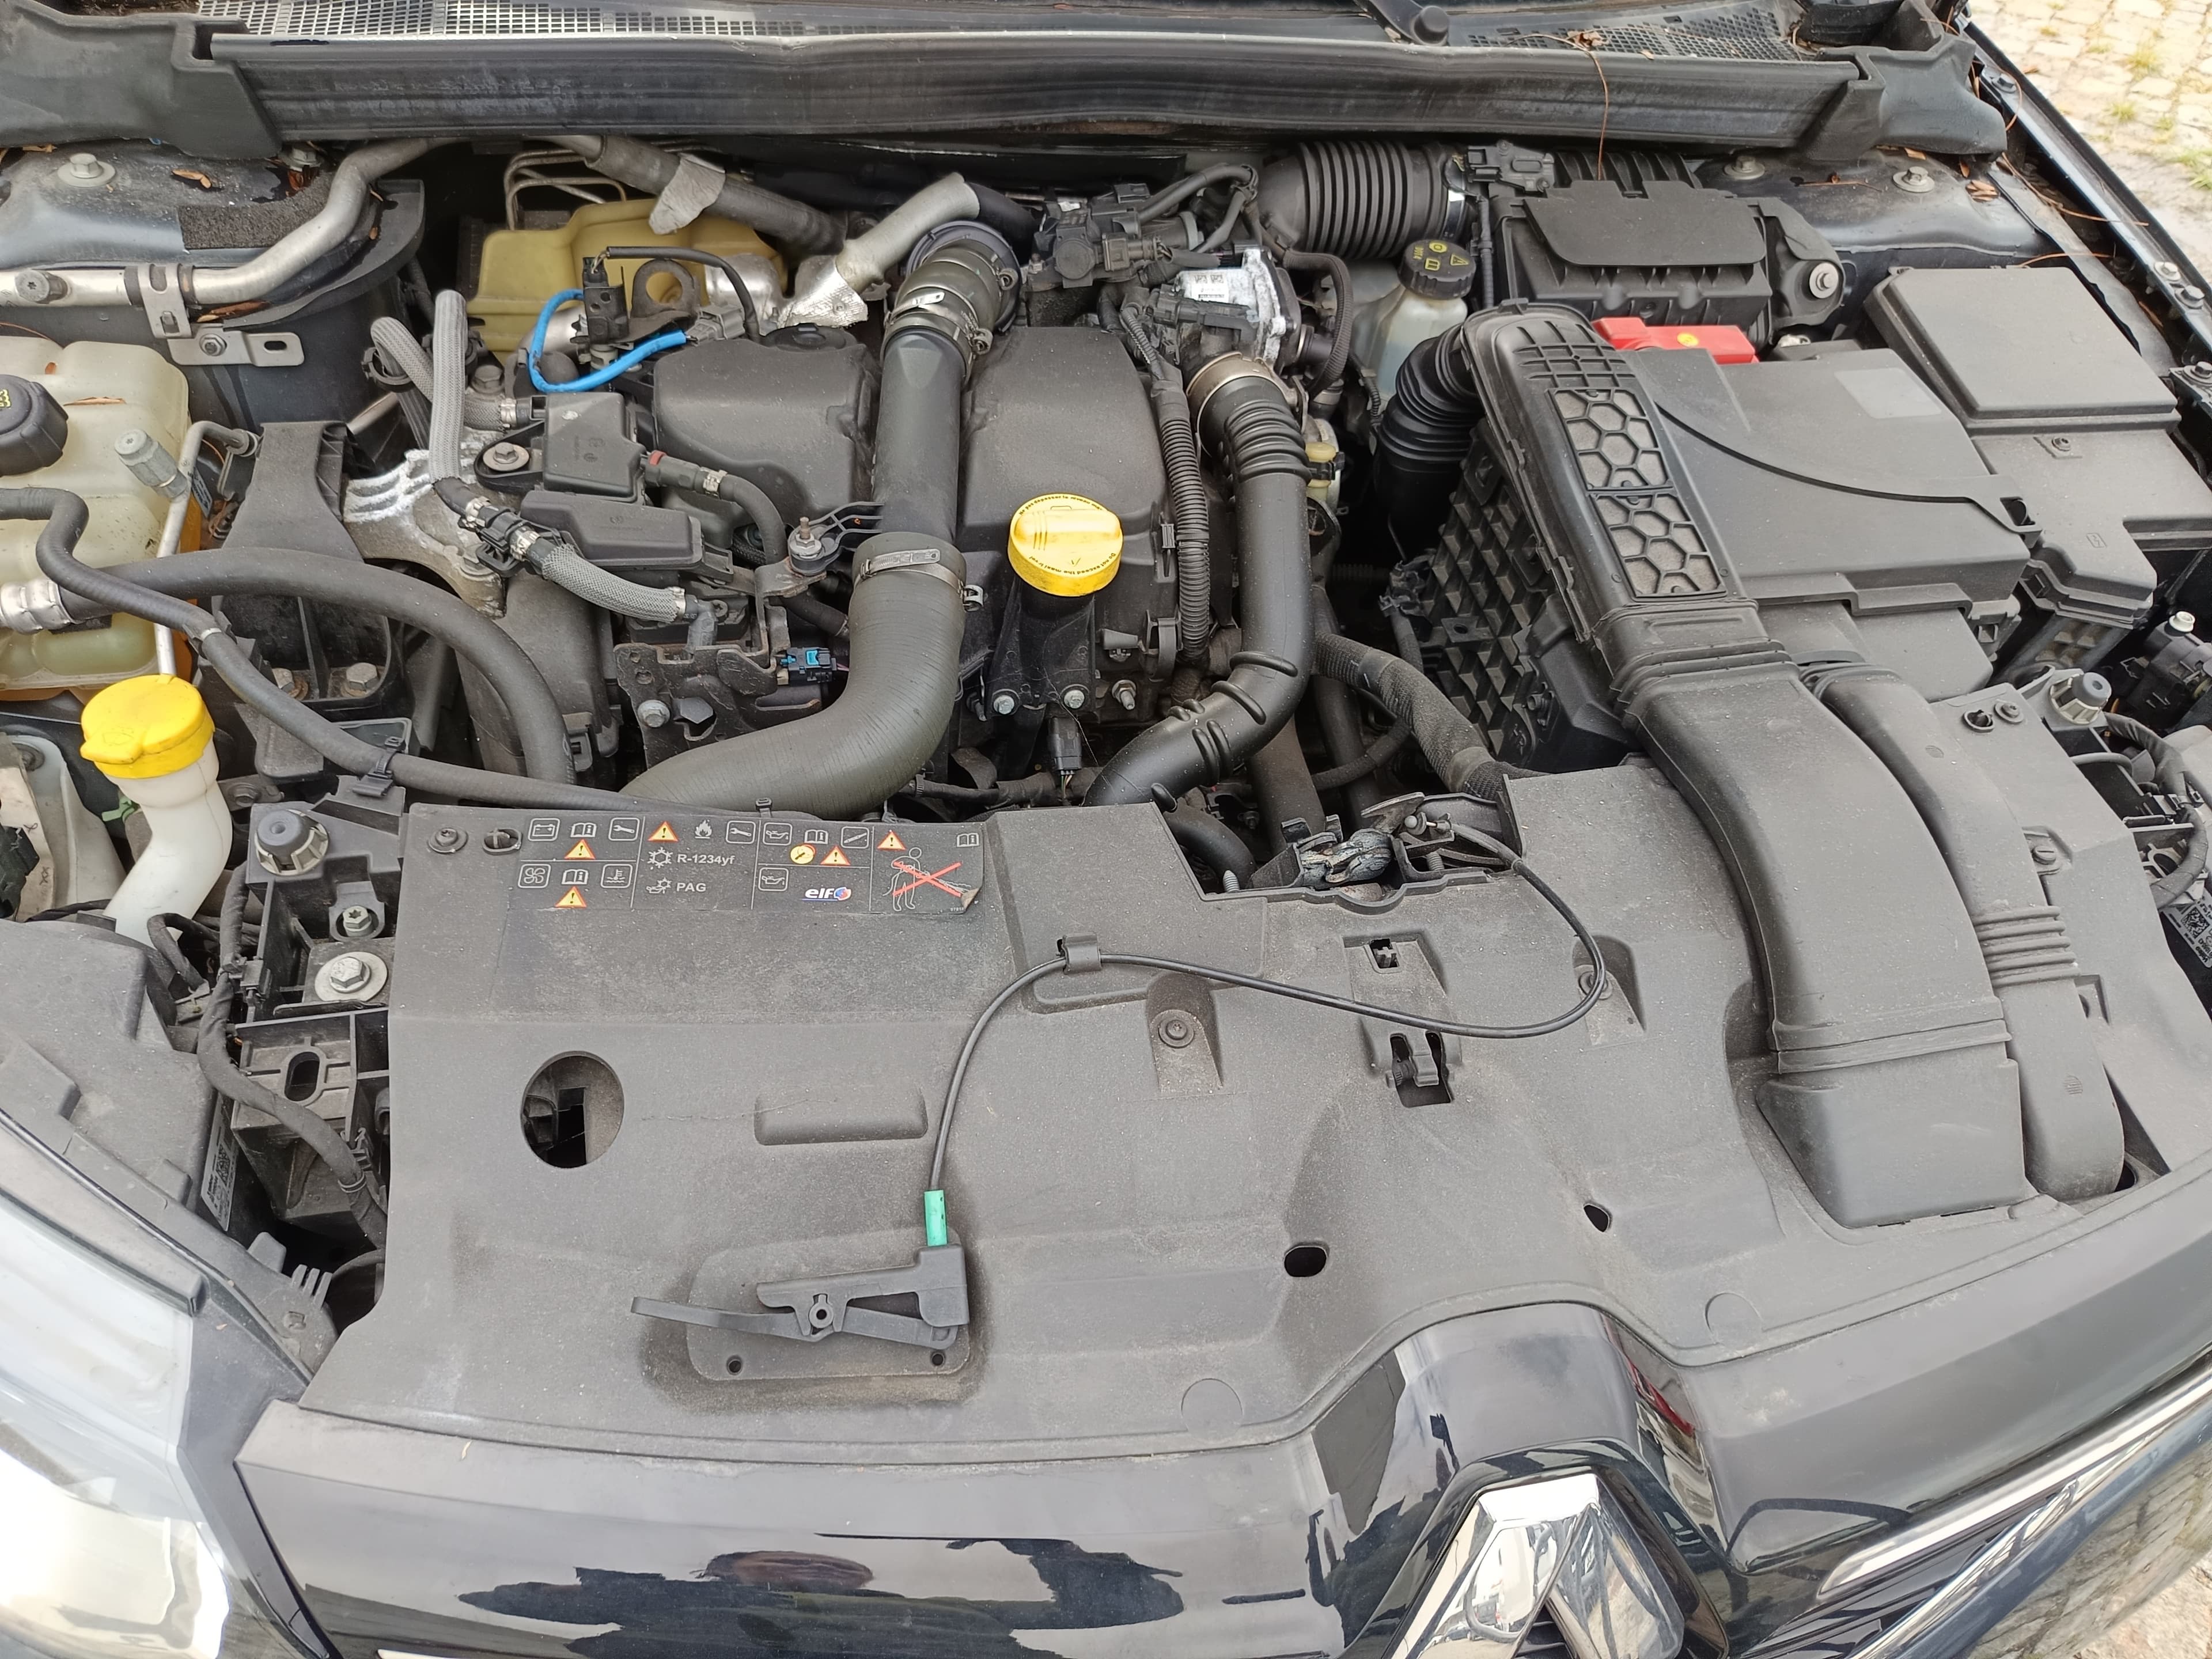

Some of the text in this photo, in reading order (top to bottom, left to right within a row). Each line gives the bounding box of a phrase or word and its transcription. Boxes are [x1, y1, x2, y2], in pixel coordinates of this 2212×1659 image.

[1077, 565, 1100, 574] exceed
[677, 854, 736, 866] R-1234yf
[676, 882, 706, 892] PAG
[805, 888, 835, 899] elf
